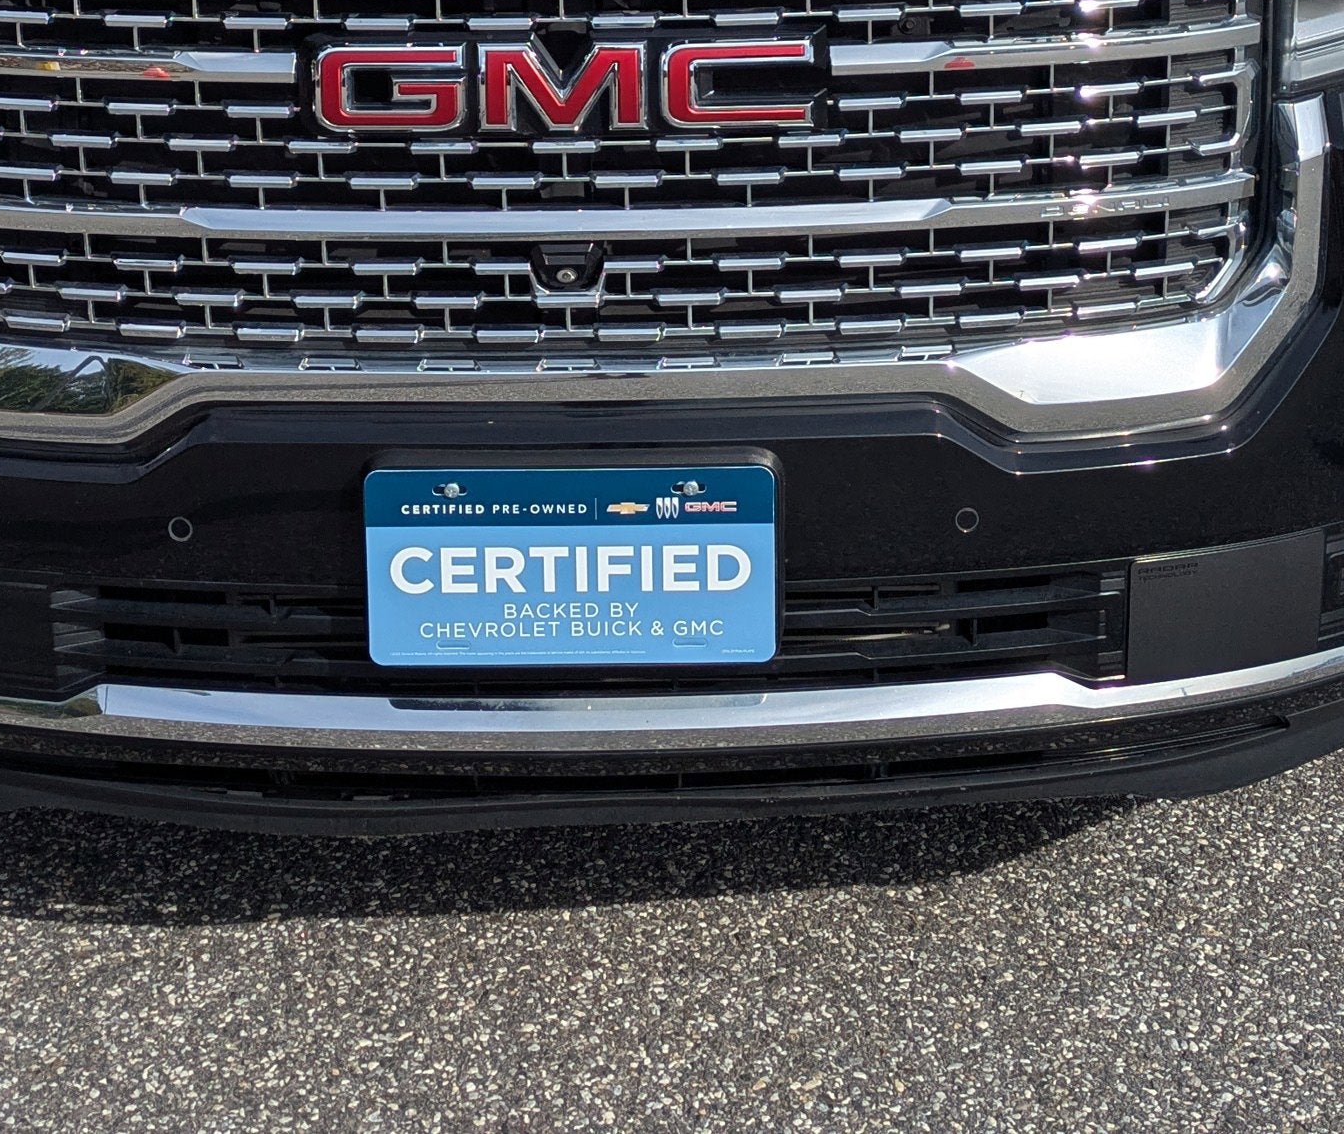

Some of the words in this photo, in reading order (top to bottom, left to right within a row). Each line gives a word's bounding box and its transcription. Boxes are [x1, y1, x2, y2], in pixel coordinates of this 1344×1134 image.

[314, 39, 818, 132] GMC
[400, 503, 486, 516] CERTIFIED
[492, 502, 588, 515] PRE-OWNED
[684, 500, 739, 513] GMC
[389, 544, 752, 595] CERTIFIED
[1138, 563, 1199, 575] RADAR
[1139, 570, 1198, 582] TECHNOLOGY
[503, 602, 600, 619] BACKED
[609, 602, 639, 618] BY
[420, 621, 559, 639] CHEVROLET
[570, 620, 642, 637] BUICK
[651, 620, 665, 636] &
[673, 619, 725, 636] GMC
